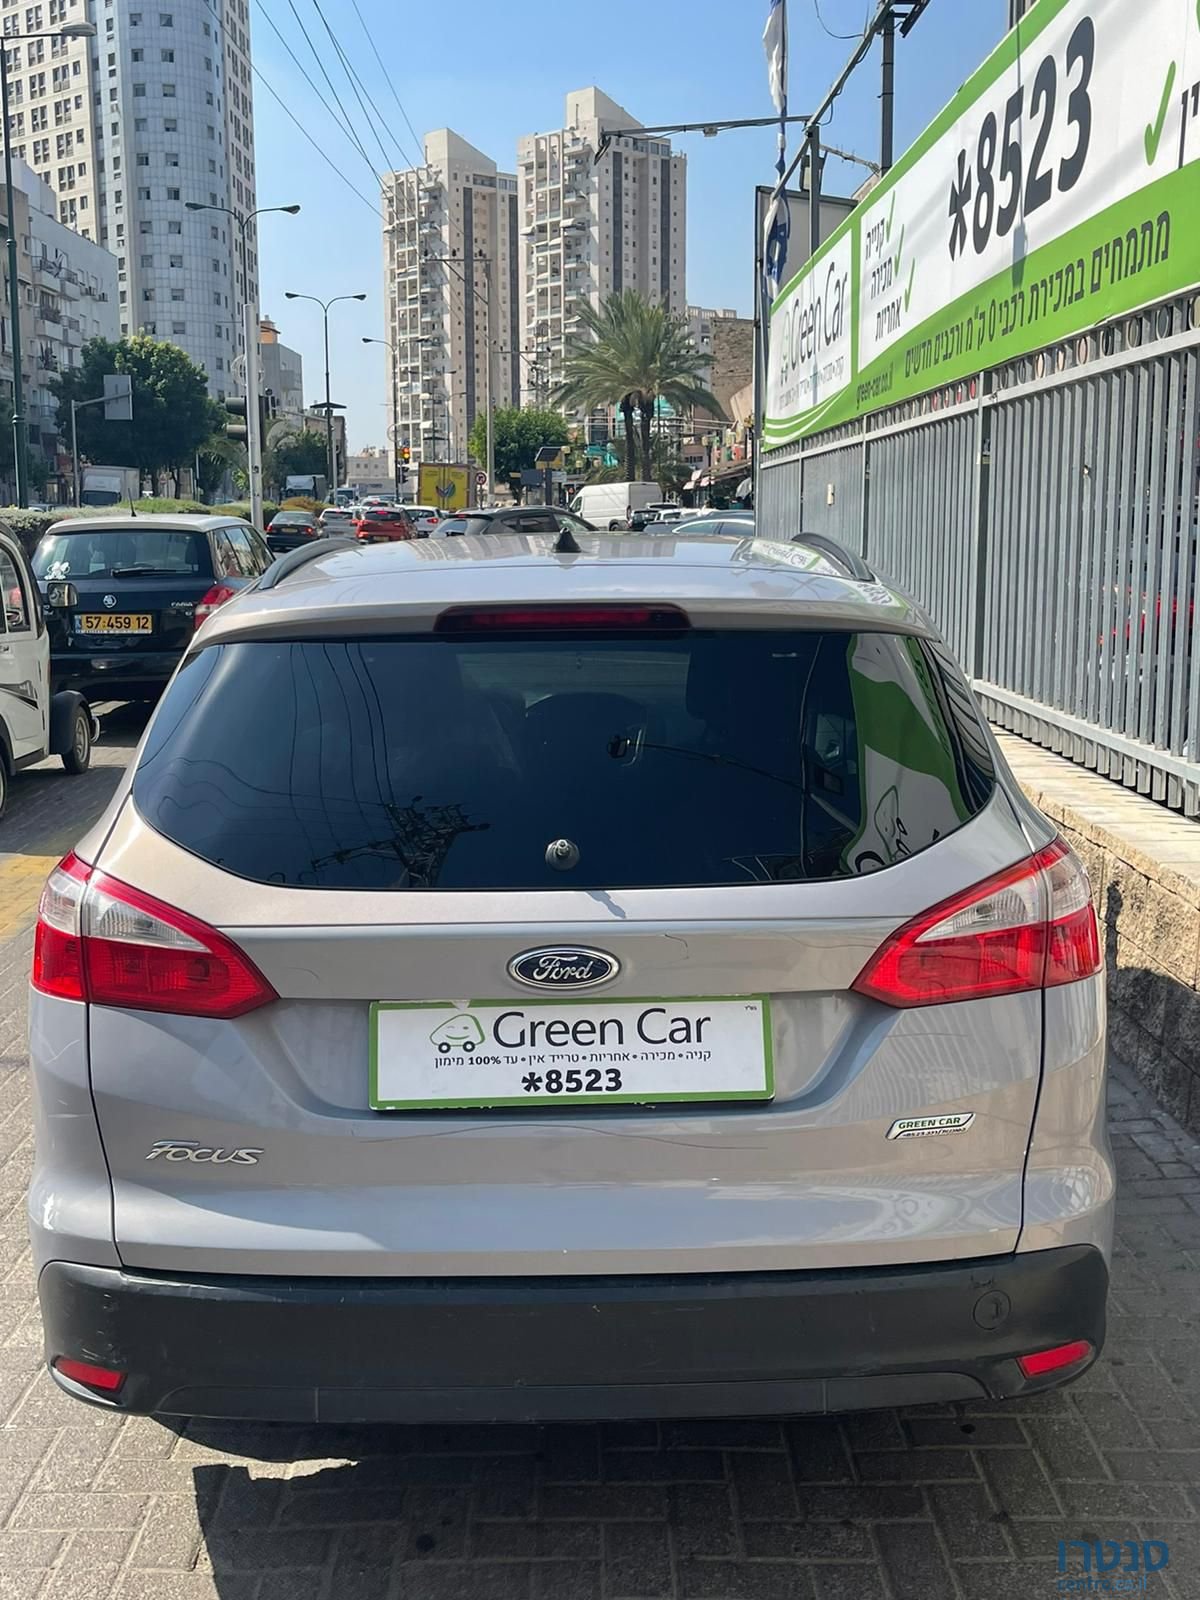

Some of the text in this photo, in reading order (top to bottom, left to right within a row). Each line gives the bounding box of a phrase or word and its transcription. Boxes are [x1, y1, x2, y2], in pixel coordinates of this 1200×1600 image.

[1090, 210, 1170, 294] מתמחים
[870, 256, 892, 300] מכירה
[1027, 258, 1085, 325] במכירת
[824, 261, 848, 346] Car
[1000, 289, 1025, 337] רכבי
[904, 338, 932, 379] חדשים
[533, 955, 594, 980] Ford
[492, 1006, 711, 1048] Green Car
[434, 1050, 711, 1069] קניה מכירה אחריות טרייד אין עד 100% מימון
[898, 1117, 961, 1129] GREEN CAR
